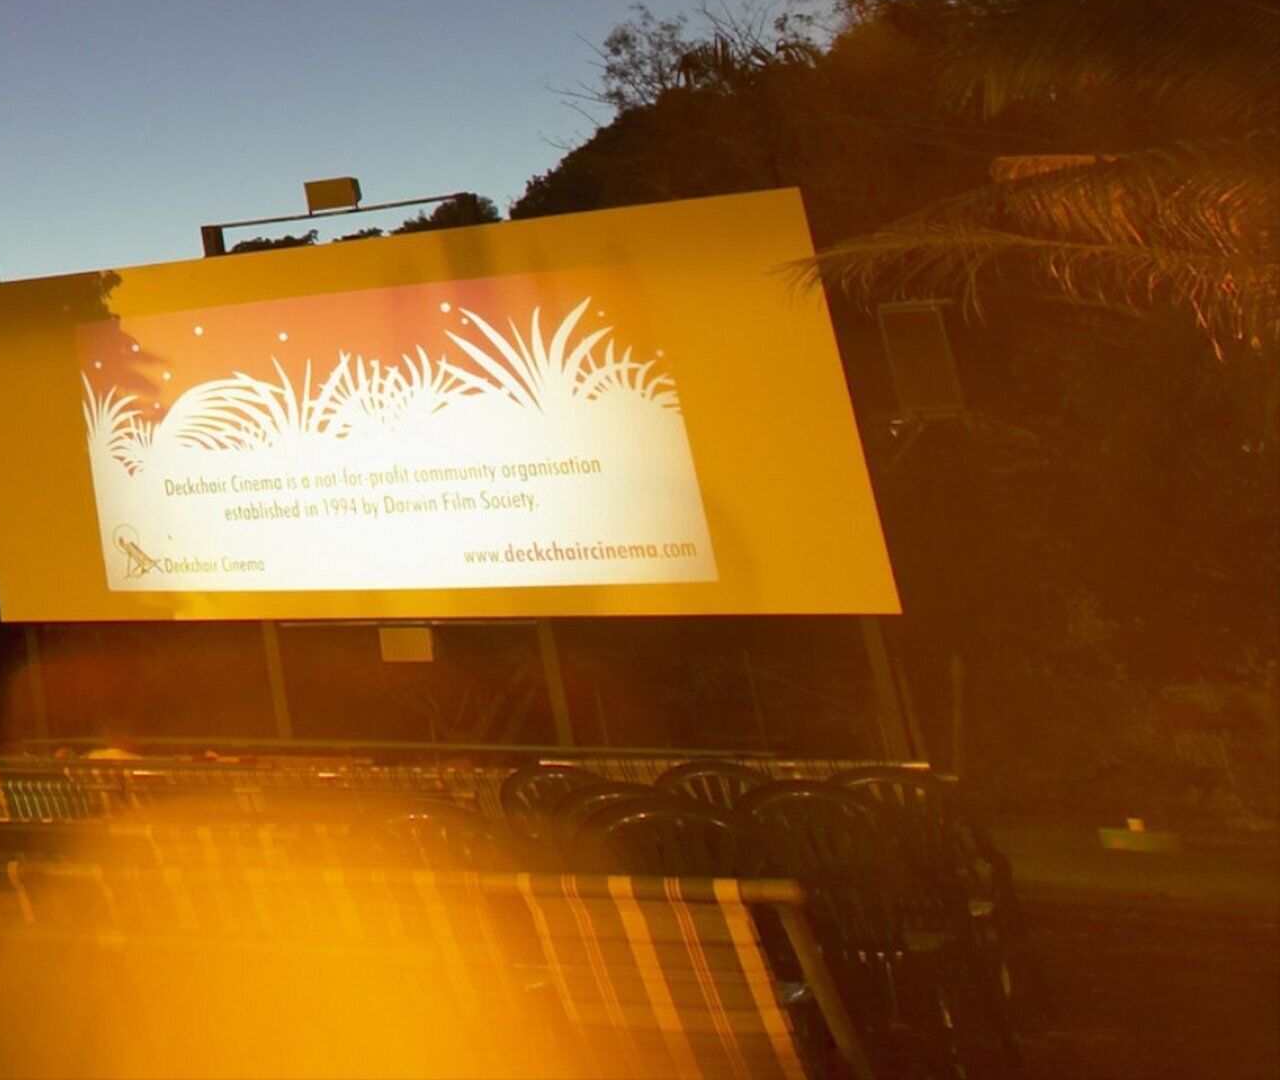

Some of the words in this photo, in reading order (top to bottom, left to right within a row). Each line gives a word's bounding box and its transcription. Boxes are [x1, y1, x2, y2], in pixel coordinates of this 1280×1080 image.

[164, 475, 227, 497] Deckchair
[230, 473, 283, 493] Cinema
[286, 474, 298, 491] is
[301, 476, 310, 489] a
[314, 464, 409, 490] not-for-profit
[413, 464, 496, 484] community
[501, 456, 602, 482] organisation
[224, 500, 301, 522] established
[304, 500, 318, 517] in
[323, 497, 358, 517] 1994
[362, 496, 379, 517] by
[383, 494, 438, 515] Darwin
[442, 492, 476, 512] Film
[480, 490, 540, 512] Society.
[164, 557, 218, 574] Deckchair
[221, 555, 265, 572] Cinema
[463, 540, 698, 564] www.deckchaircinema.com
